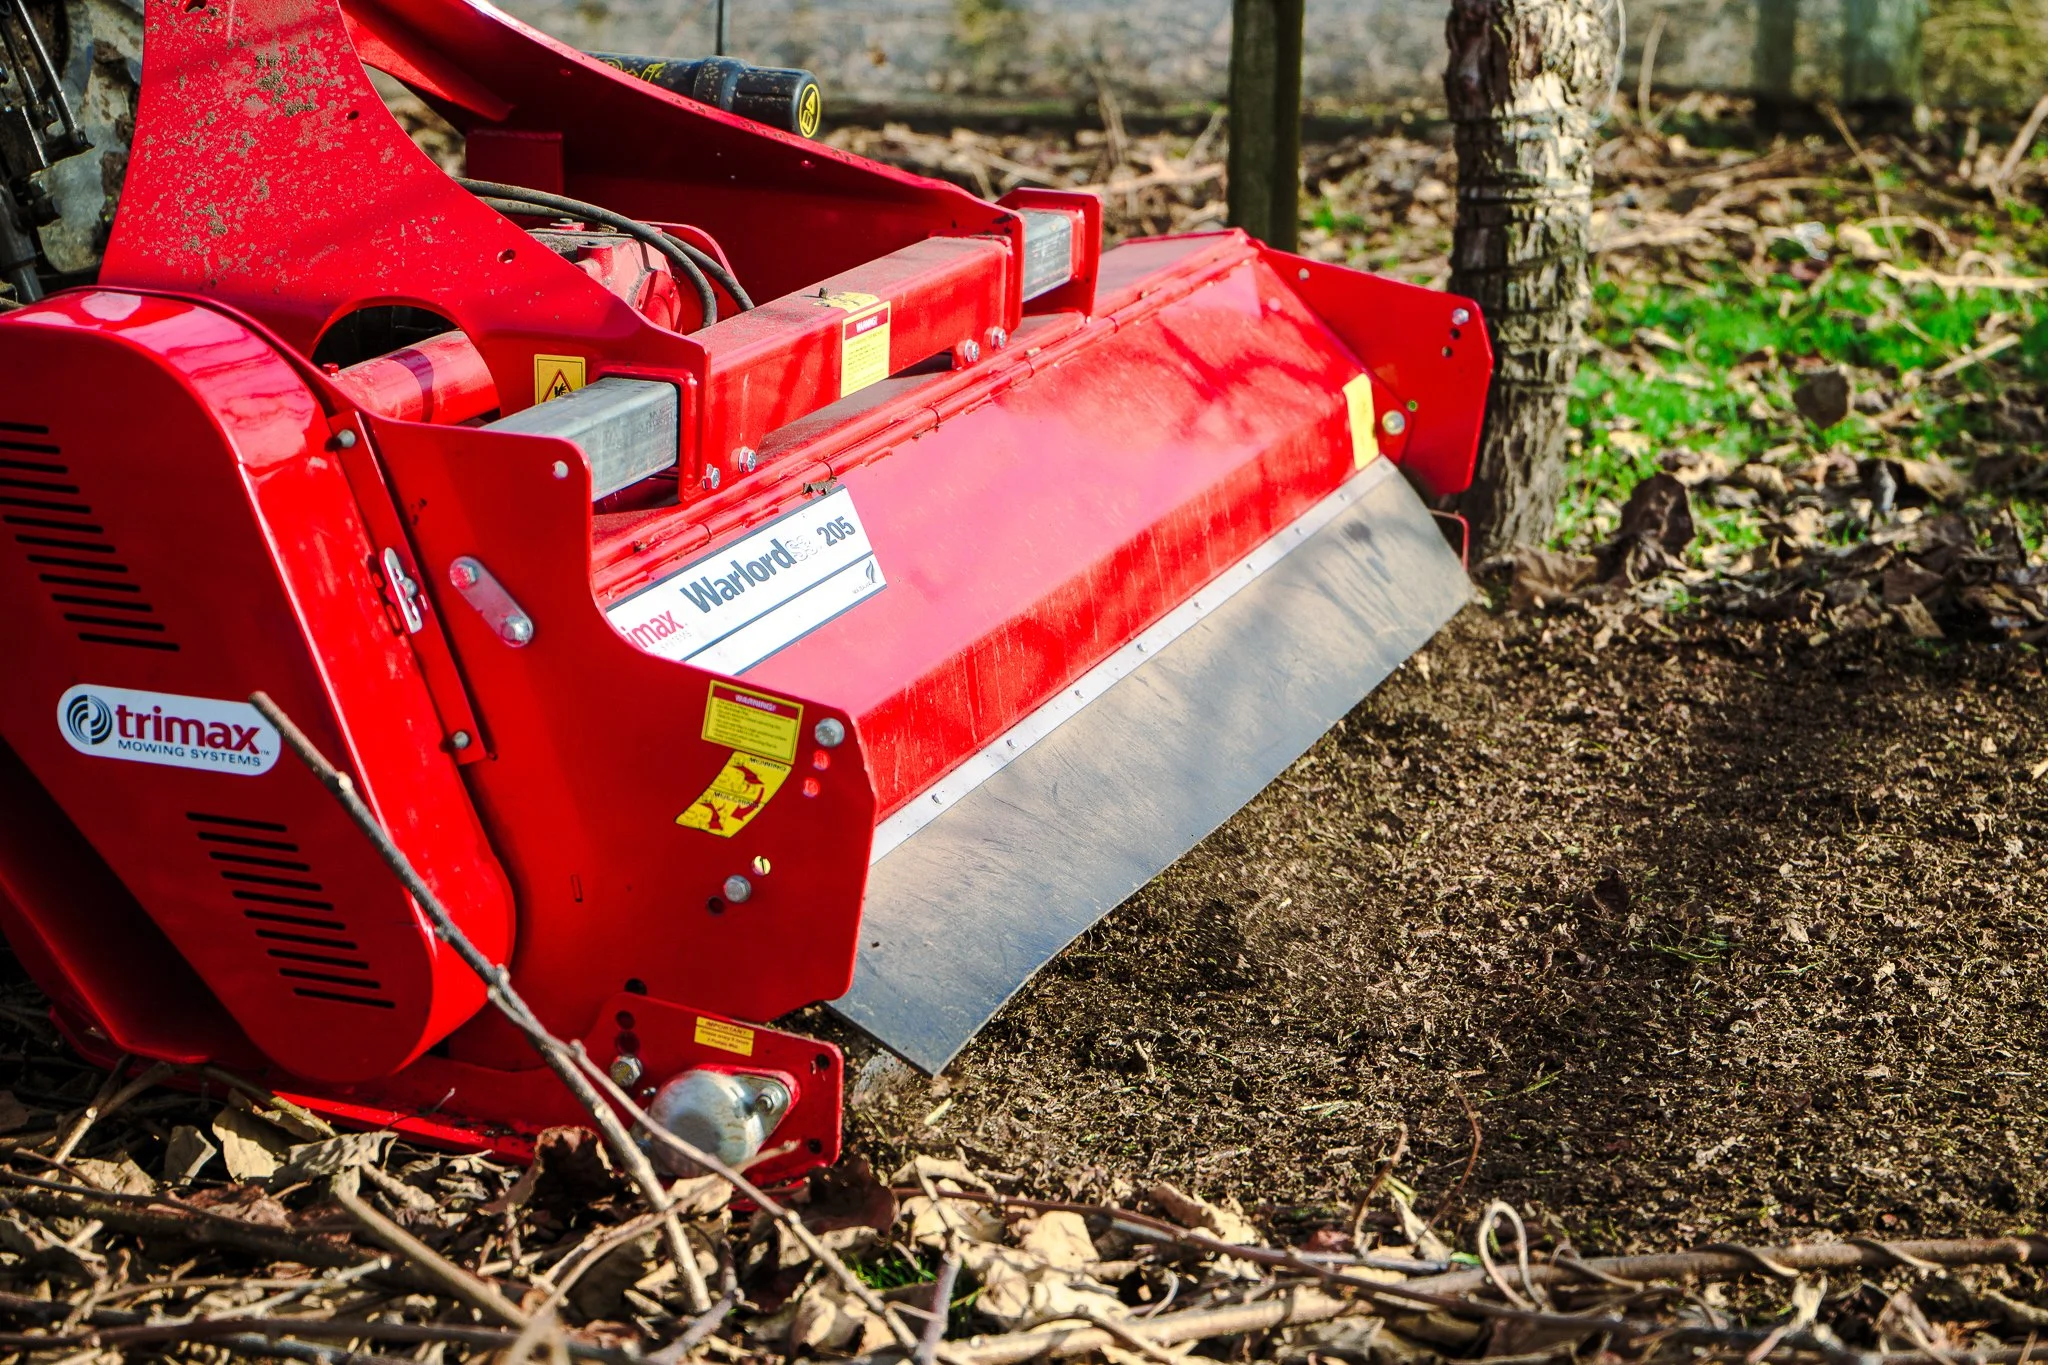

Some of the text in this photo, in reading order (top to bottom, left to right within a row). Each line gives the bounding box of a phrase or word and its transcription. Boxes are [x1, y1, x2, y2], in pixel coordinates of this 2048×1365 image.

[621, 610, 684, 649] imax
[680, 538, 797, 614] Warlord
[816, 516, 856, 547] 205
[115, 704, 260, 755] trimax
[118, 739, 261, 767] MOWING SYSTEMS
